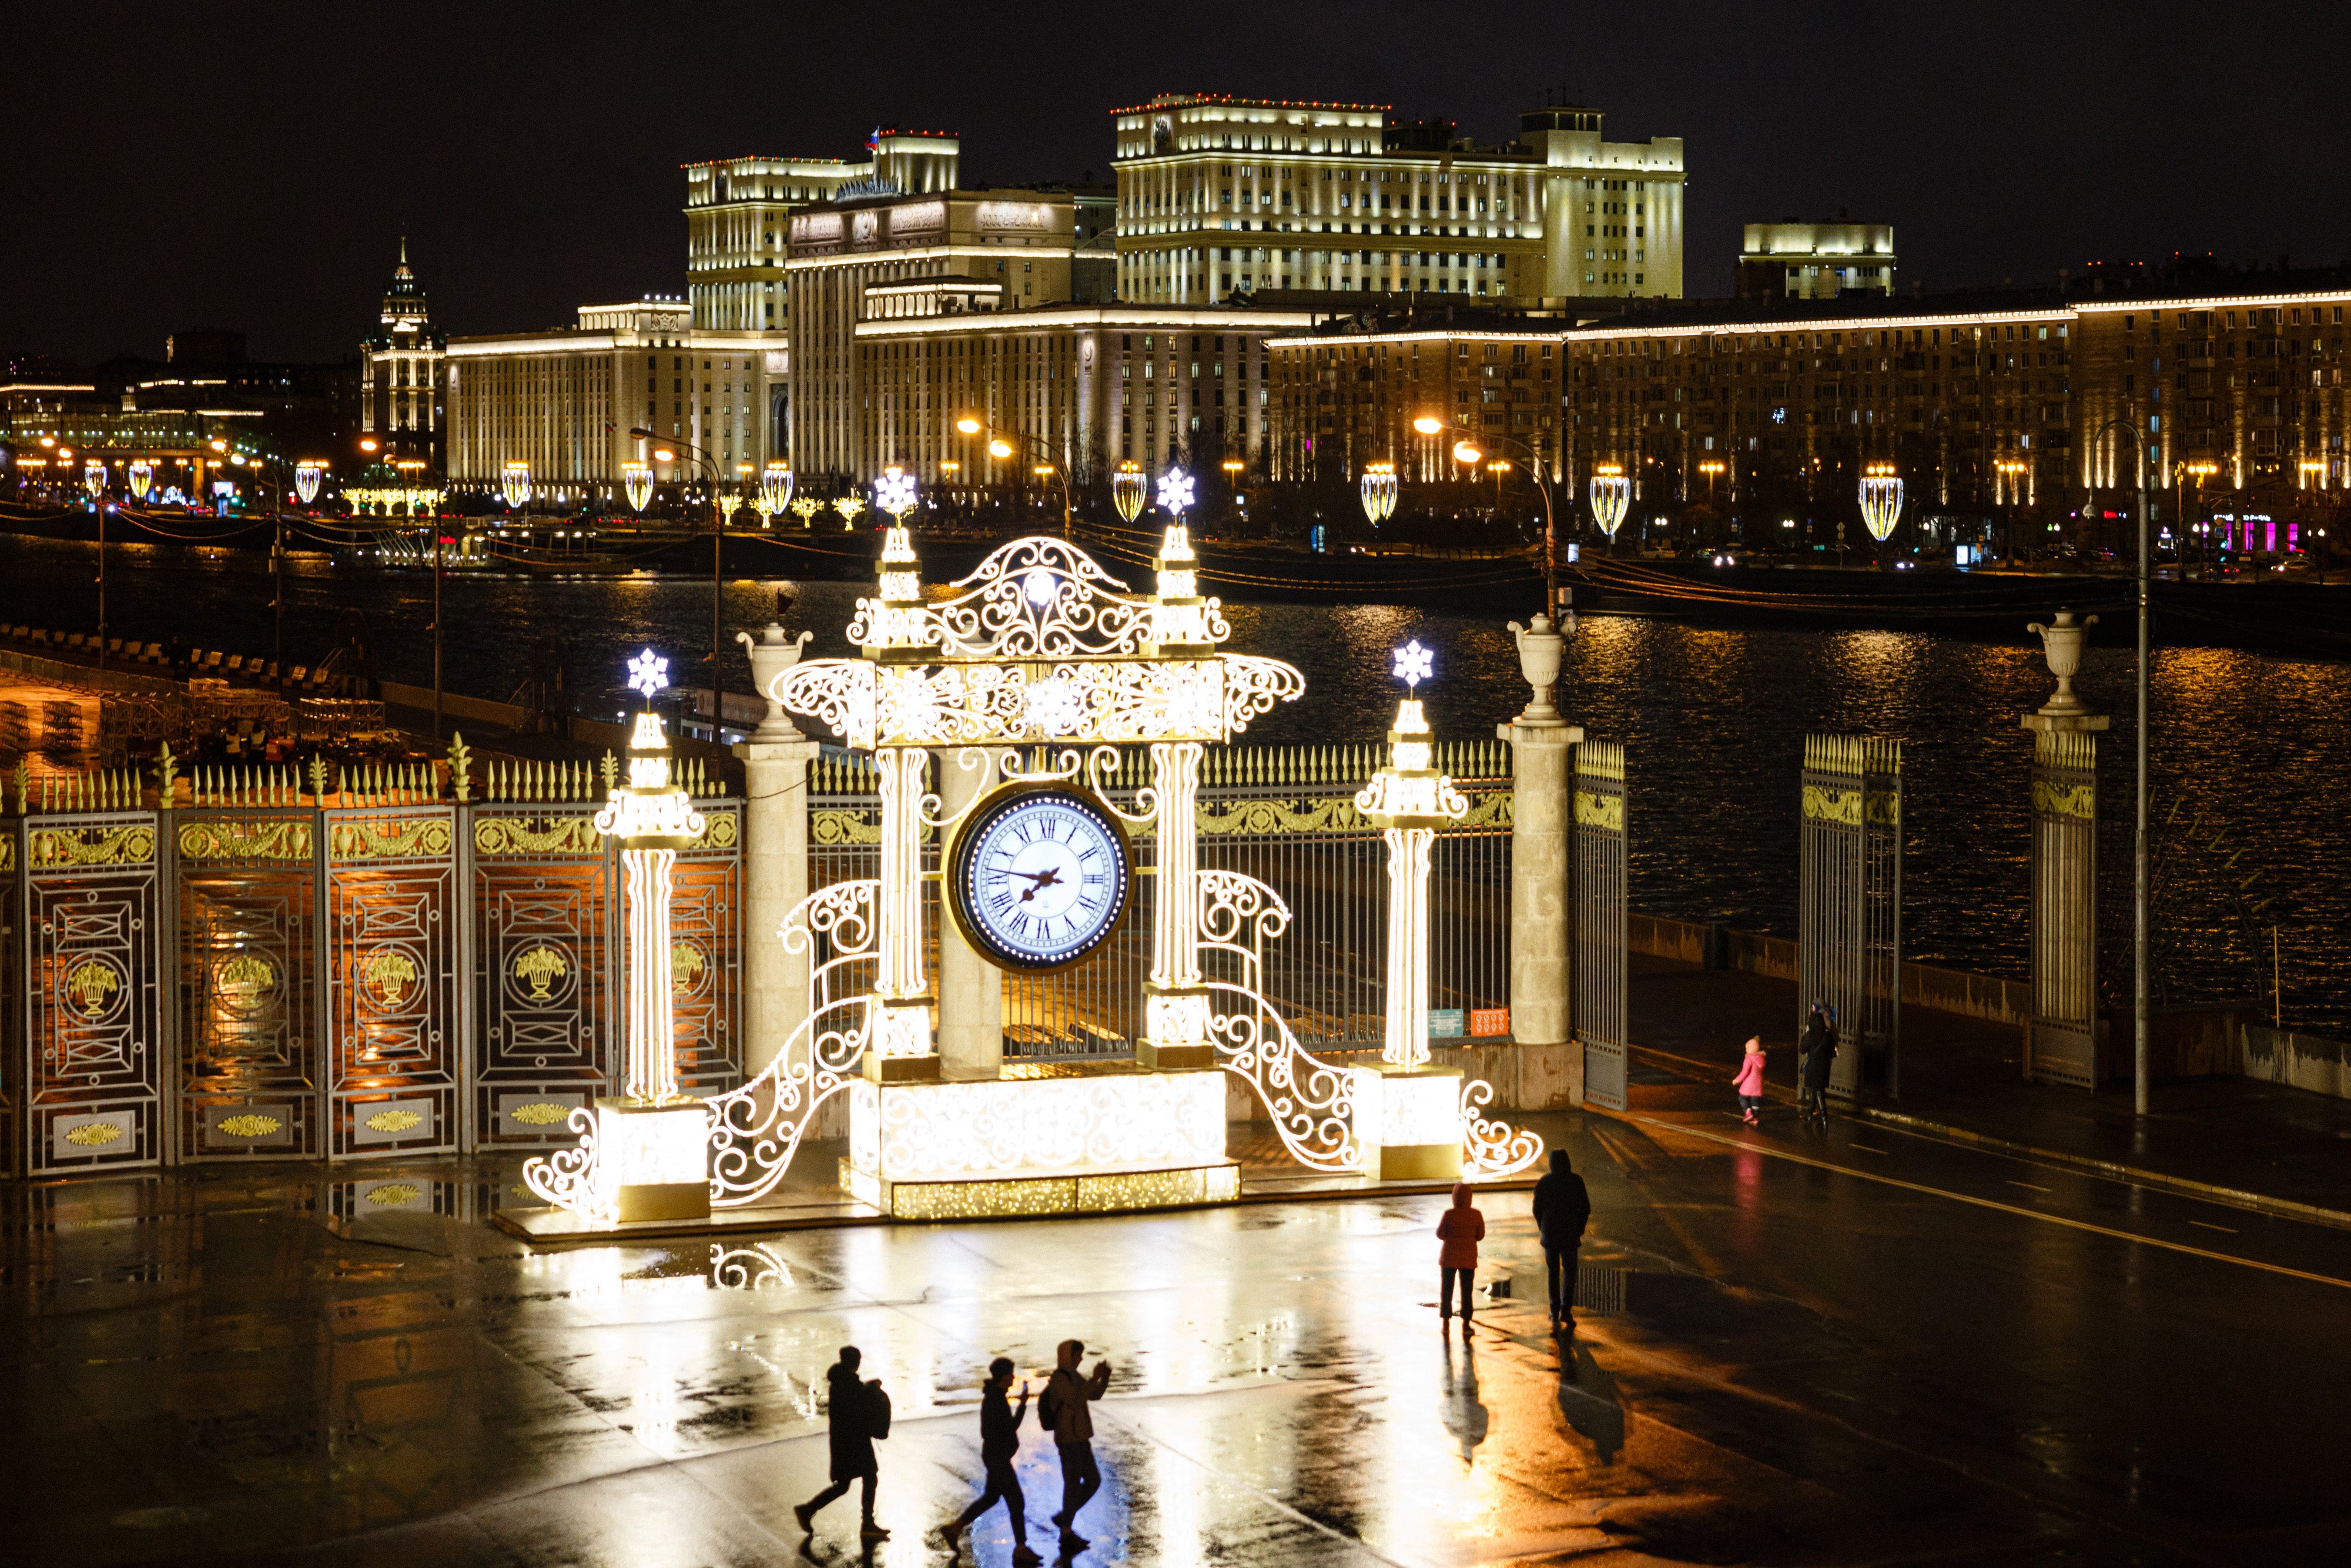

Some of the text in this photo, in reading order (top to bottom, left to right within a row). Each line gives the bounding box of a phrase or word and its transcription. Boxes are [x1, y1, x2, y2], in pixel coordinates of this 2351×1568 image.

[1014, 824, 1030, 846] XI
[1040, 819, 1056, 839] XII
[1066, 826, 1077, 843] I
[994, 846, 1014, 862] X
[1079, 847, 1098, 862] II
[988, 872, 1007, 884] IX
[1084, 875, 1103, 884] III
[992, 892, 1014, 917] VIII
[1078, 896, 1098, 913] IV
[1009, 912, 1029, 934] VII
[1037, 919, 1050, 939] VI
[1064, 914, 1077, 933] V
